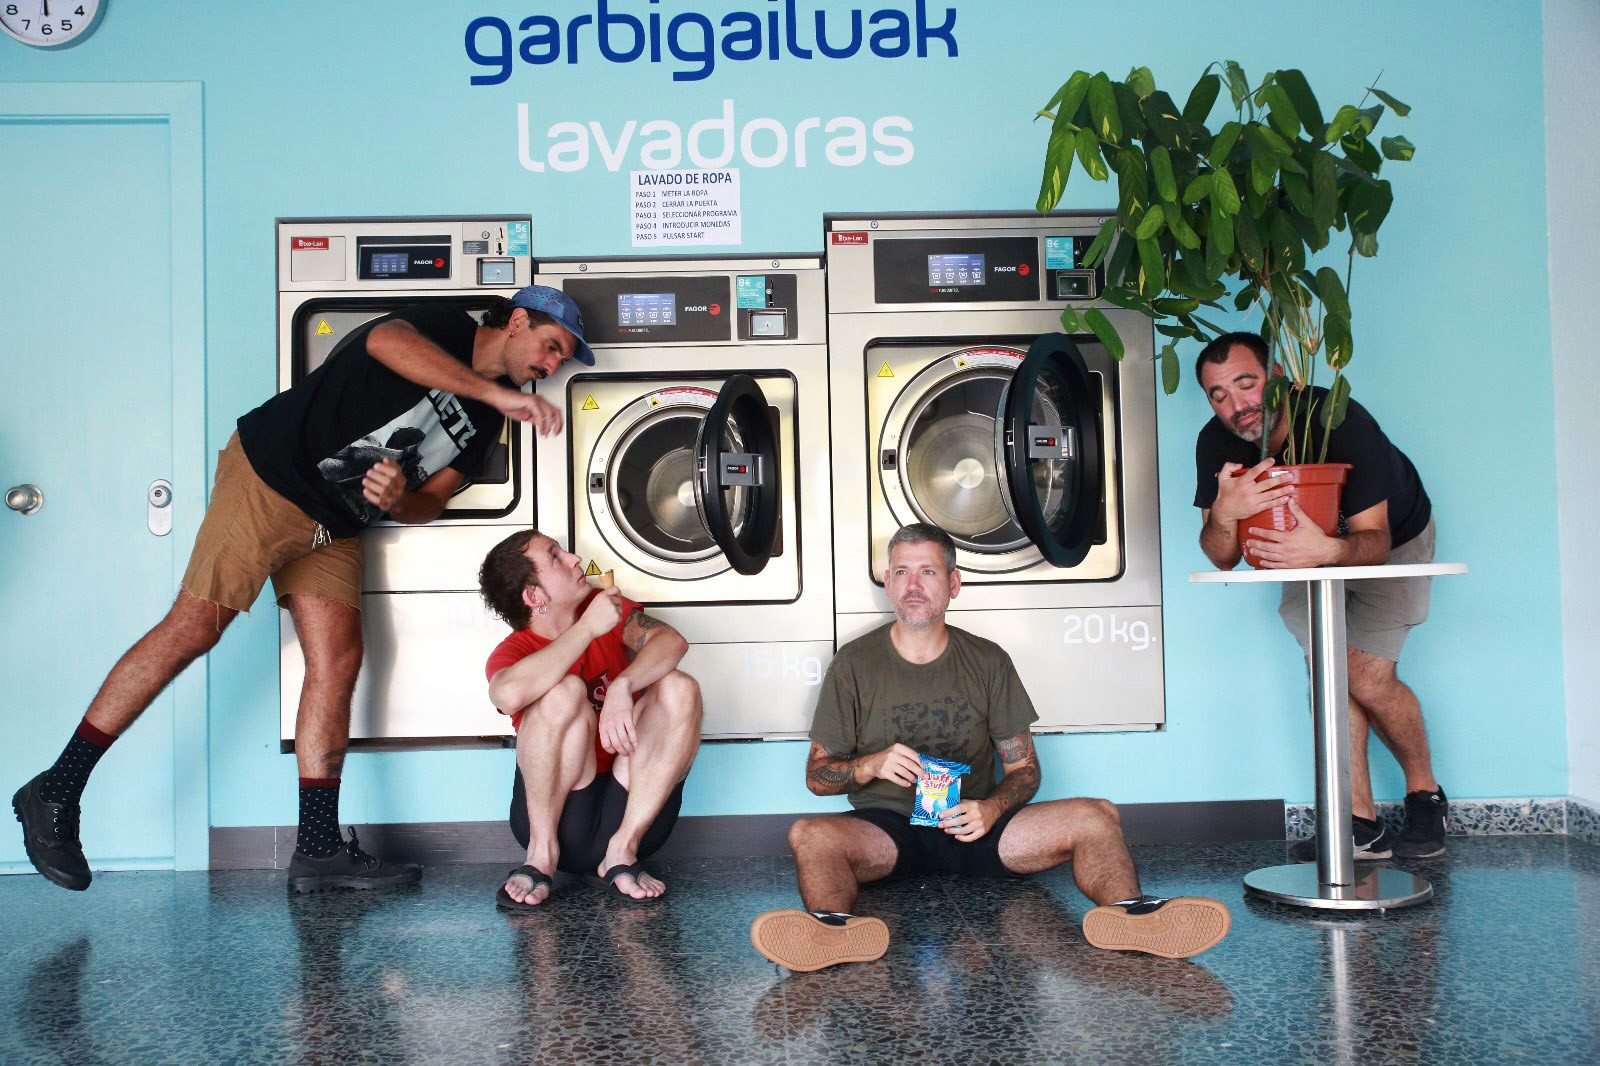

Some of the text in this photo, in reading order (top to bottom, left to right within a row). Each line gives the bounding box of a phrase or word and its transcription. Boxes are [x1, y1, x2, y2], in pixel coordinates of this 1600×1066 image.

[6, 4, 18, 16] 8
[74, 5, 85, 16] 4
[21, 19, 31, 31] 7
[41, 24, 53, 35] 6
[61, 20, 73, 31] 5
[465, 0, 959, 86] garbigailuak
[516, 99, 915, 173] lavadoras
[638, 173, 732, 186] LAVADO DE ROPA
[691, 189, 708, 197] ROPA
[662, 200, 685, 208] CERRAR
[662, 211, 701, 219] SELECCIONAR
[515, 223, 528, 233] 5€
[662, 221, 699, 229] INTRODUCIR
[700, 220, 731, 228] MONEDAS
[686, 231, 705, 239] START
[1047, 239, 1060, 248] 9€
[738, 278, 751, 287] 8€
[1063, 613, 1157, 651] 20 kg.
[739, 648, 774, 680] 15
